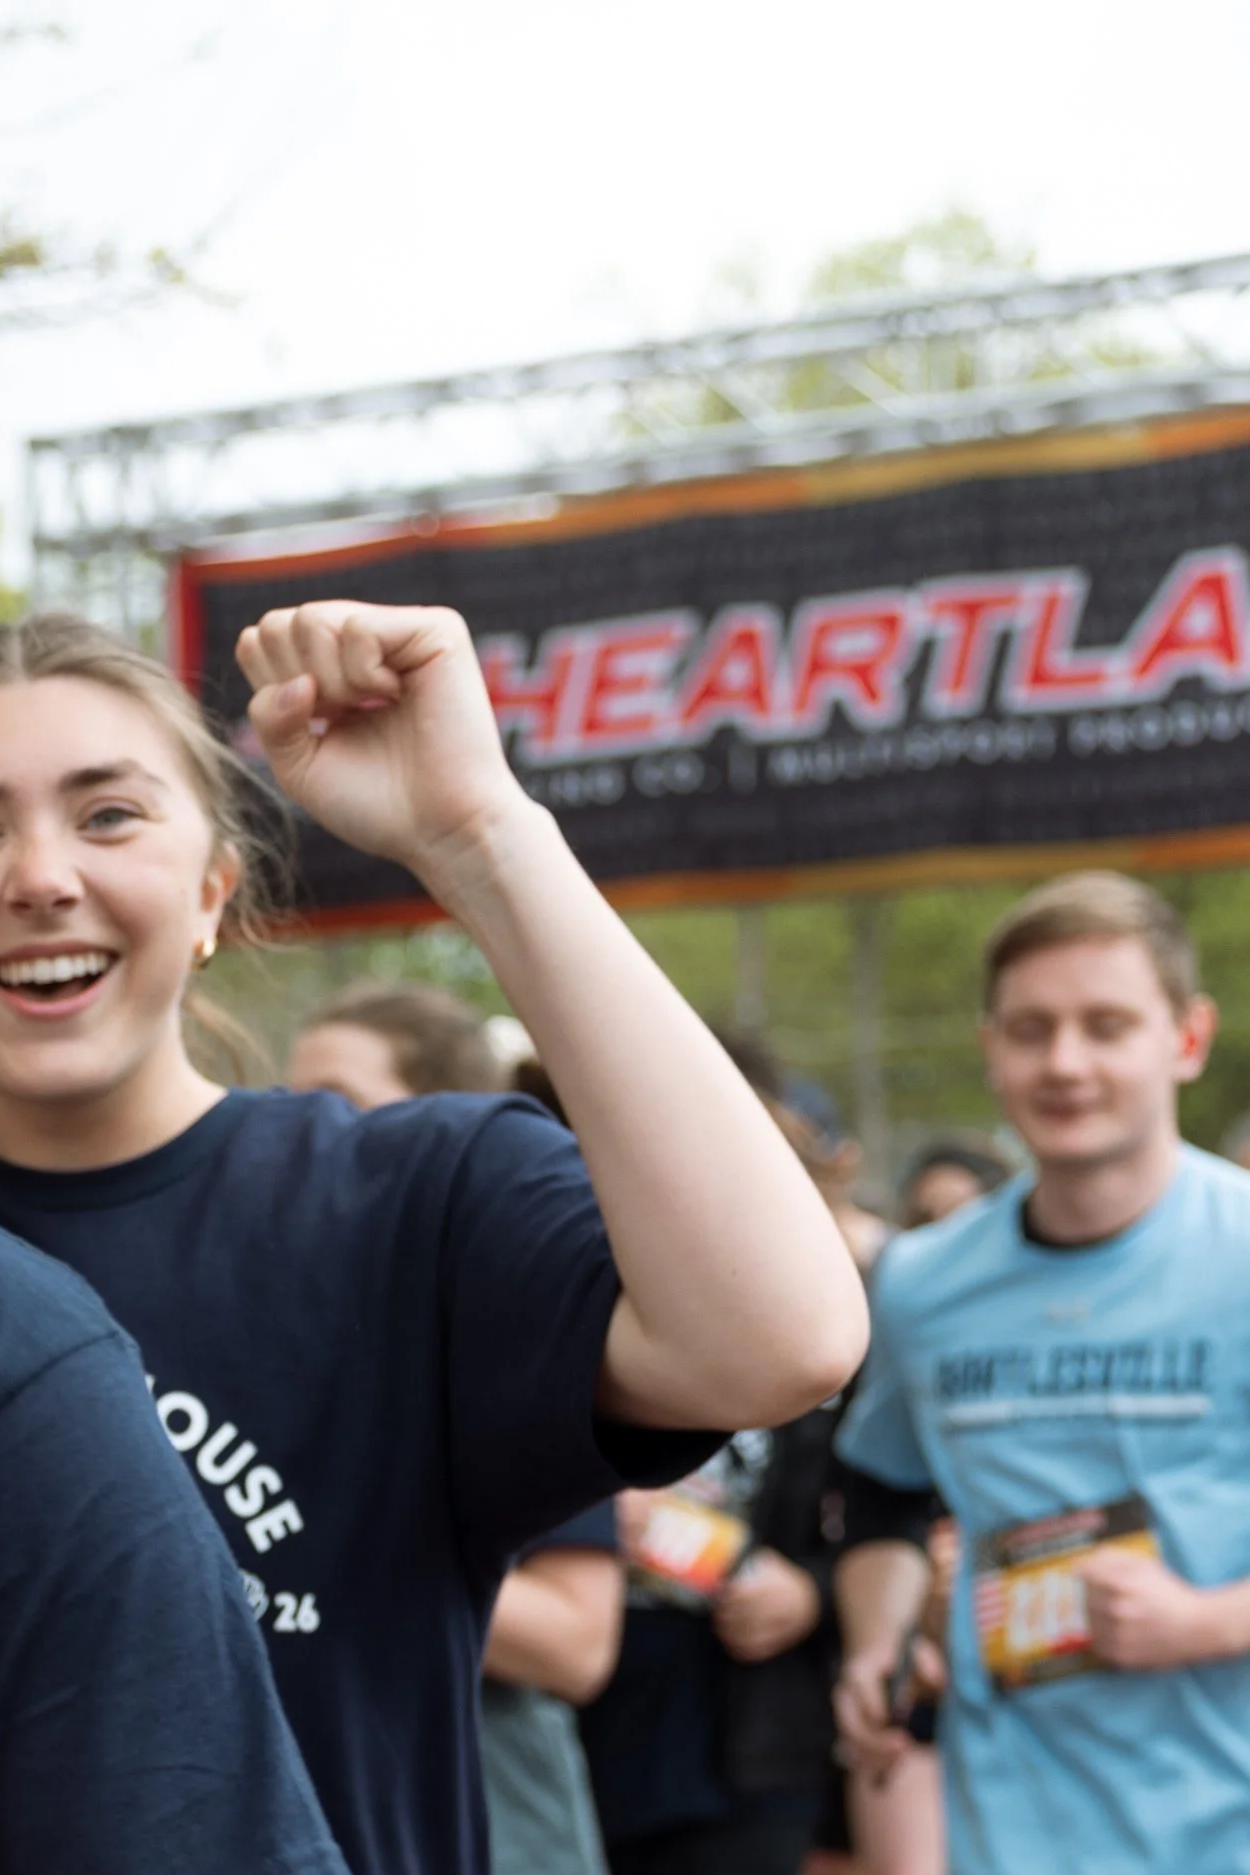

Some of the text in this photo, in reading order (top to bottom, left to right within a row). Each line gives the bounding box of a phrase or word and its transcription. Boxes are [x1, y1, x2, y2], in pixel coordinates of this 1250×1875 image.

[480, 545, 1250, 760] HEARTLA
[145, 1373, 305, 1554] OUSE
[272, 1592, 321, 1633] 26
